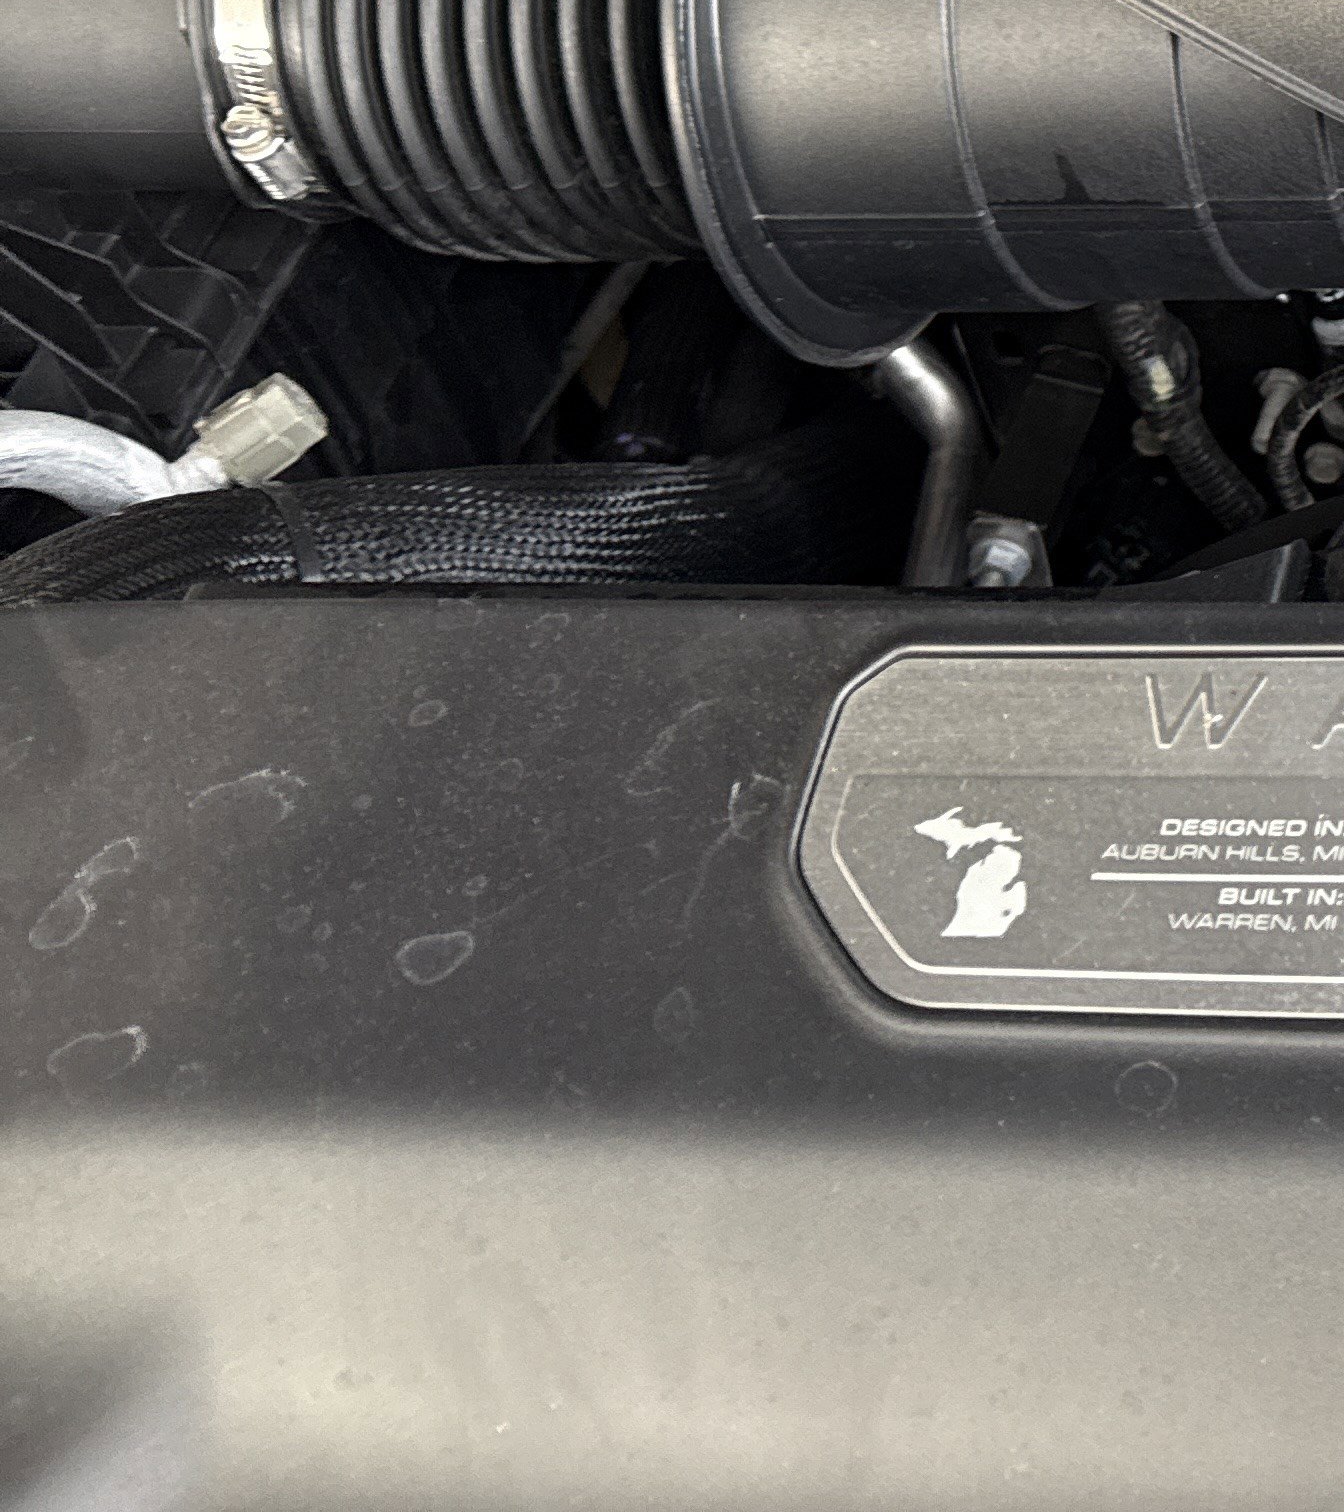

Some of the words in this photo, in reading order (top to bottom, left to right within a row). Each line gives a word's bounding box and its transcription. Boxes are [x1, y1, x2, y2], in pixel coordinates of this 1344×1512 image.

[1160, 818, 1308, 837] DESIGNED
[1101, 843, 1221, 861] AUBURN
[1225, 844, 1306, 863] HILLS,
[1218, 888, 1302, 906] BUILT
[1306, 888, 1344, 907] IN:
[1167, 913, 1297, 933] WARREN,
[1304, 914, 1338, 931] MI
